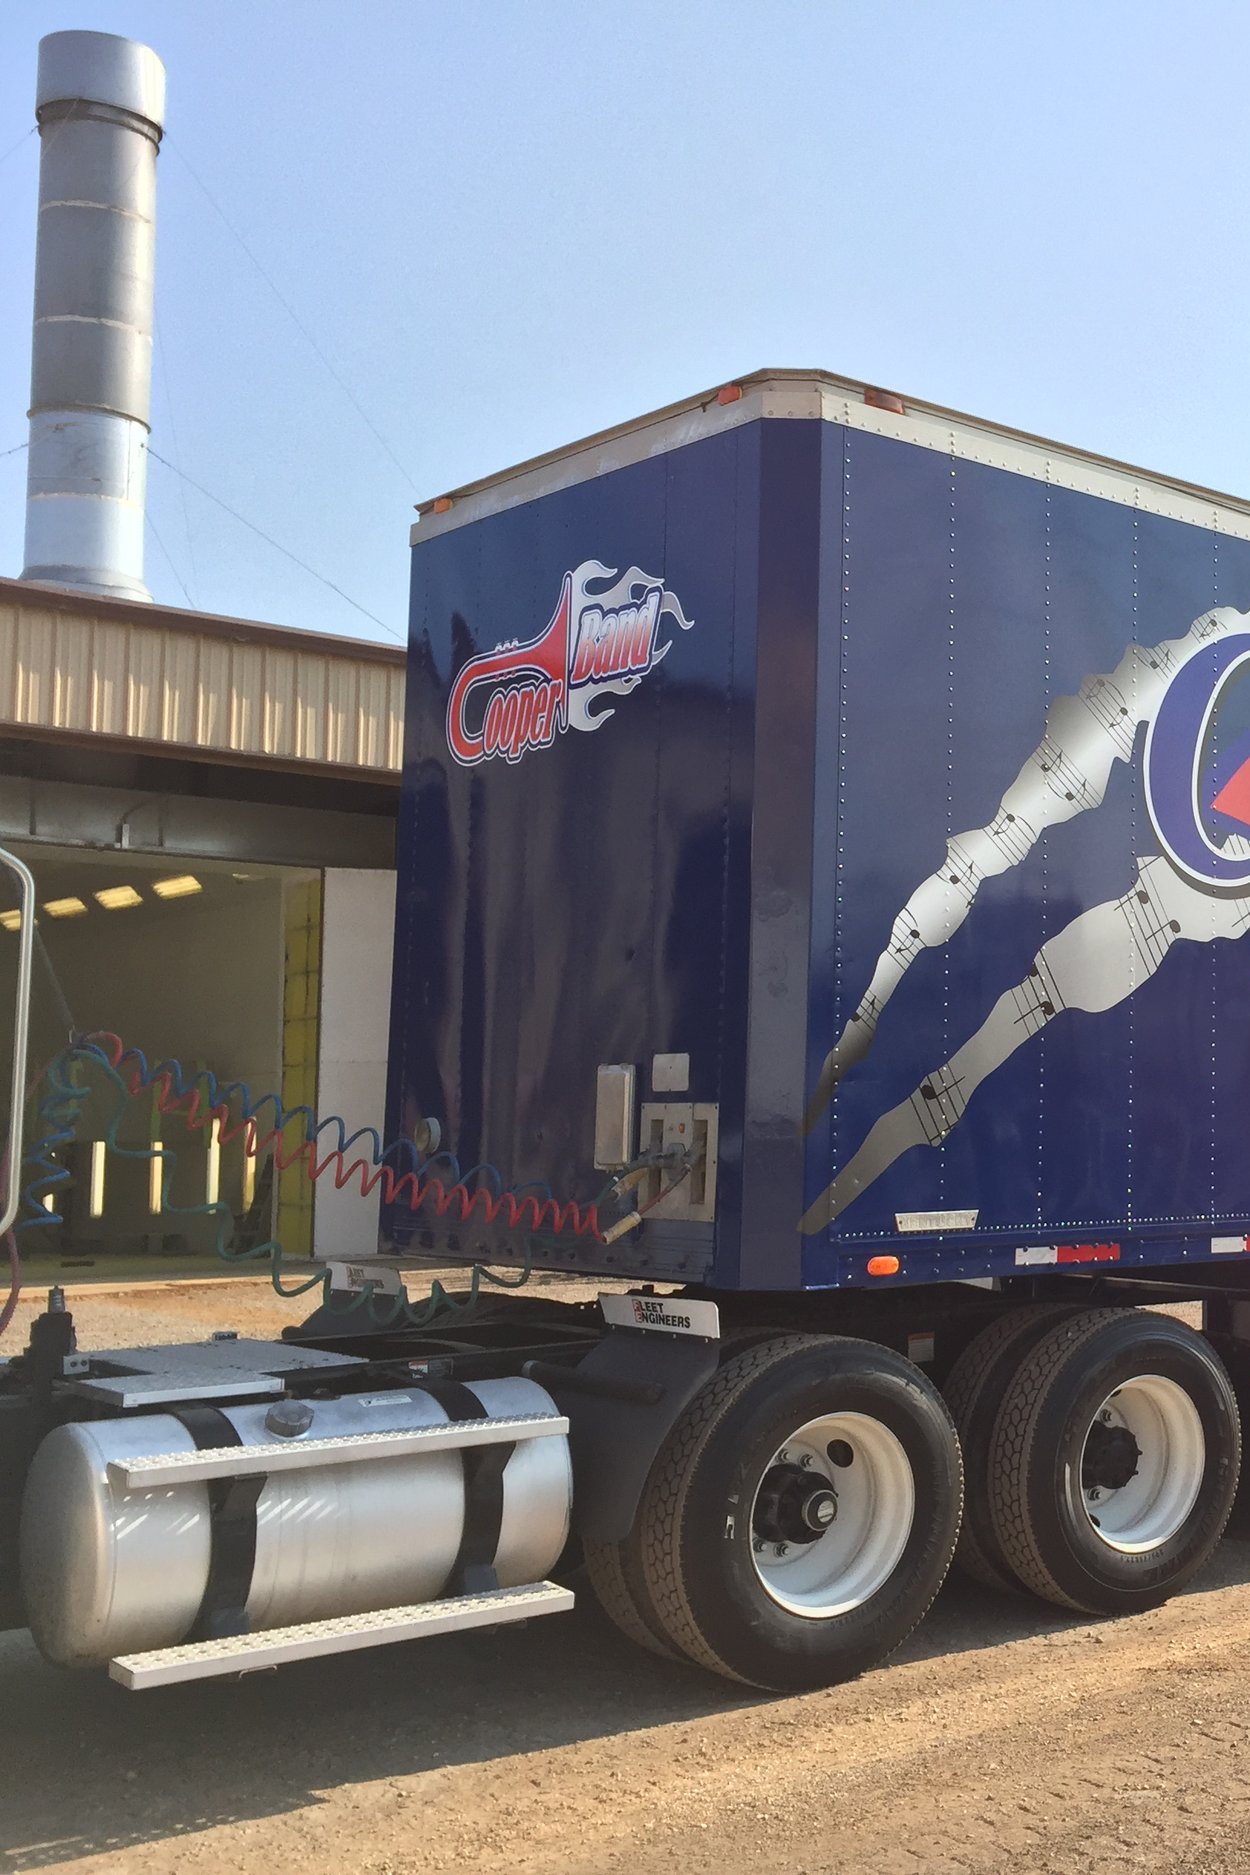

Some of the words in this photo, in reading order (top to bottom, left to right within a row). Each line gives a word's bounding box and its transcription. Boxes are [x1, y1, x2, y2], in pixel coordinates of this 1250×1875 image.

[572, 592, 660, 682] Band
[446, 660, 566, 765] Cooper
[632, 1300, 663, 1313] FLEET
[635, 1311, 691, 1328] ENGINEERS
